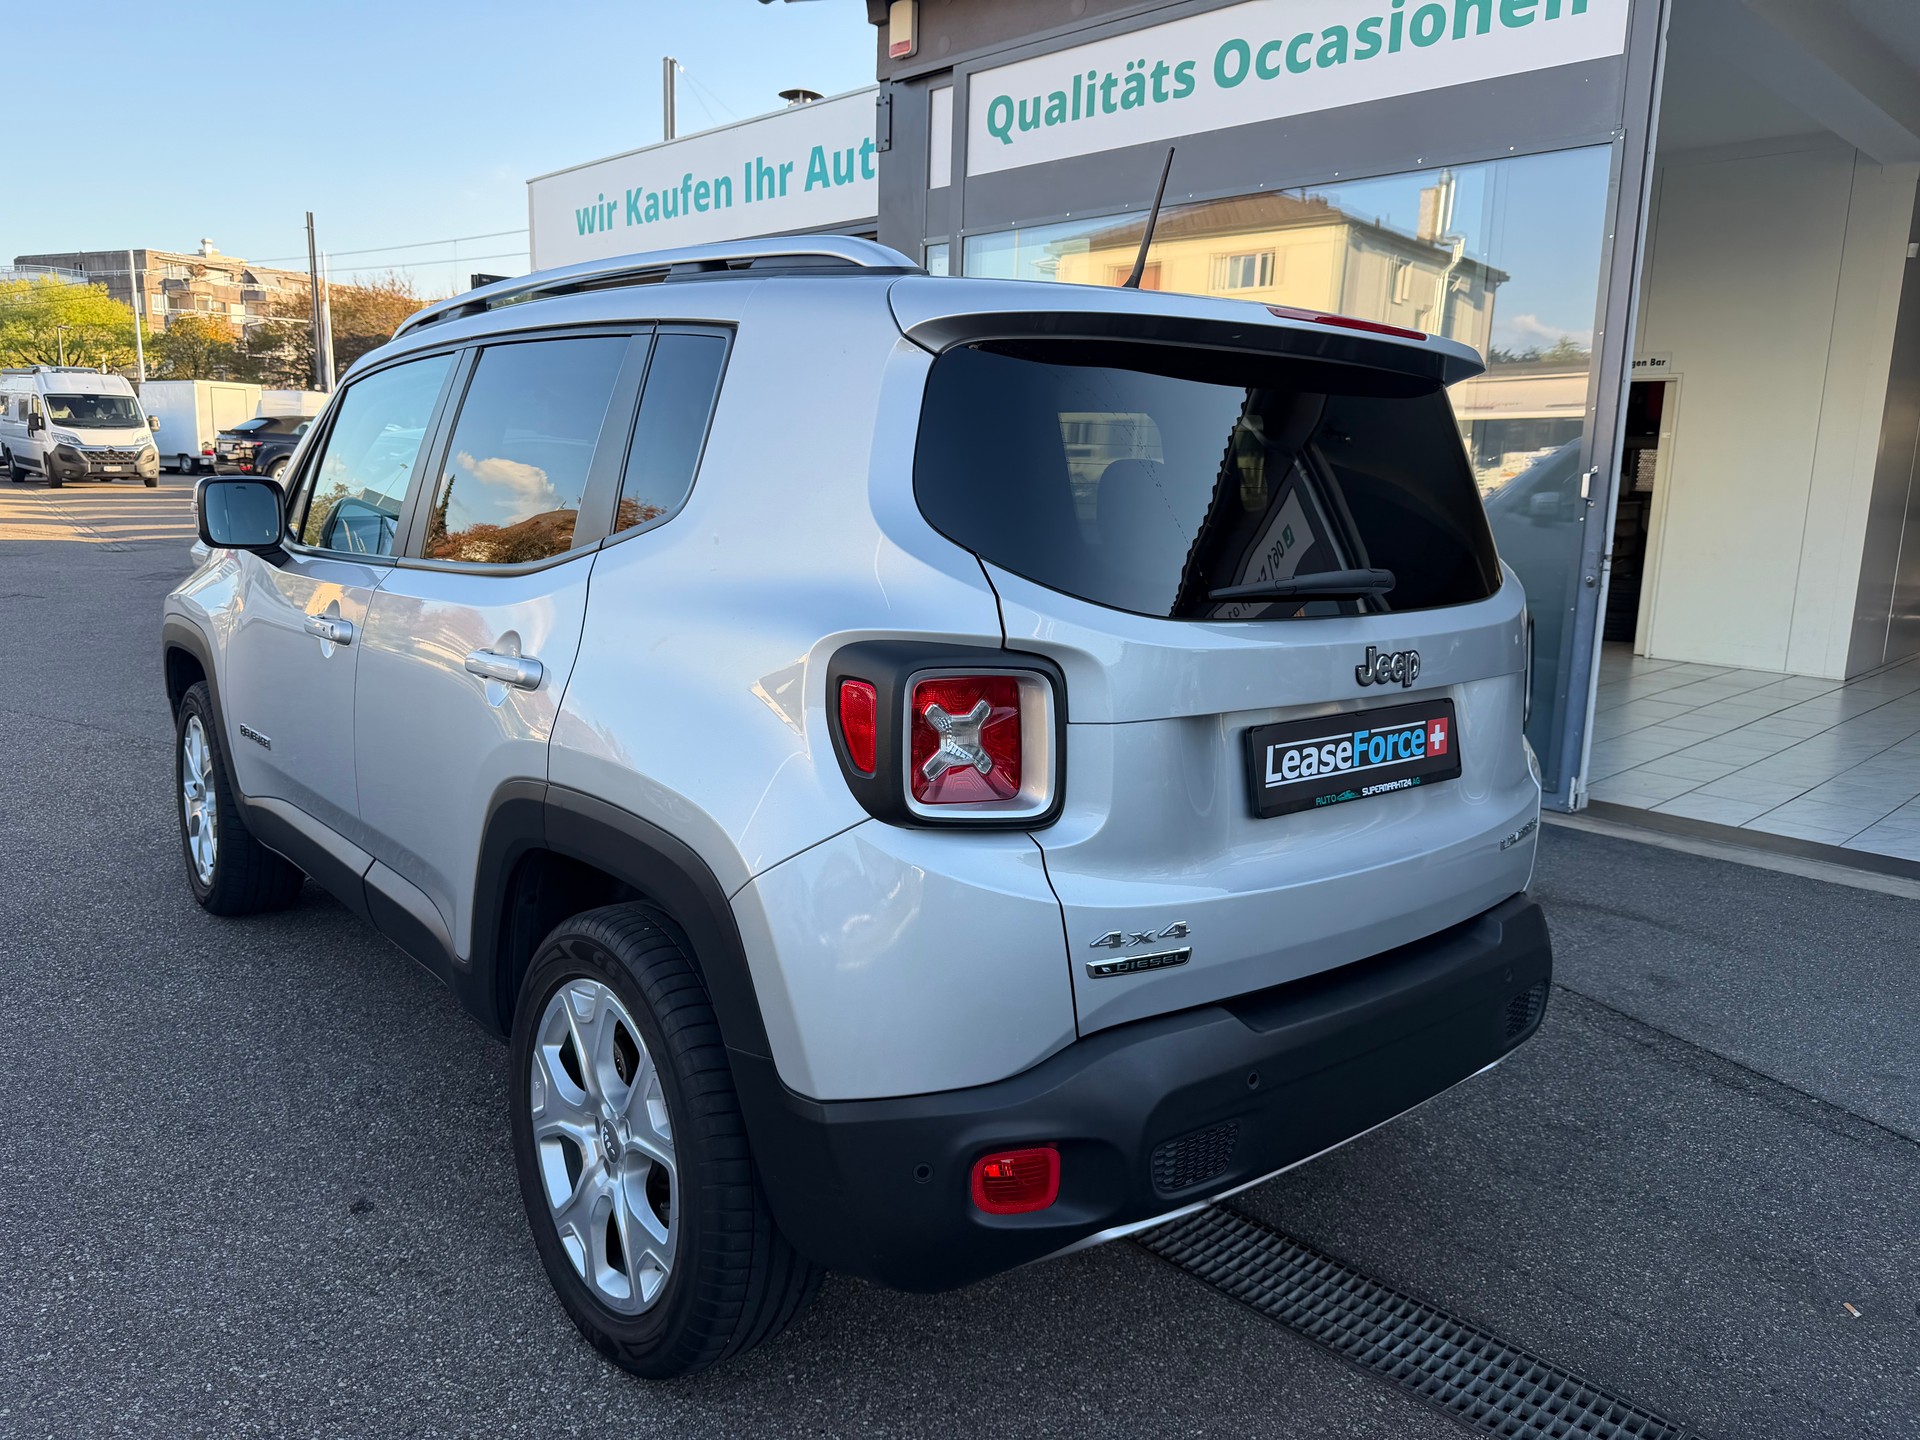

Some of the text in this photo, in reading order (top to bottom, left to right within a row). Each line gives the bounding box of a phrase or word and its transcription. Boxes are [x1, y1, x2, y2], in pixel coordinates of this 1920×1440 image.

[986, 58, 1196, 146] Qualitäts
[575, 137, 876, 236] wir Kaufen Ihr Aut
[1650, 358, 1666, 366] Bar
[1355, 646, 1420, 687] Jeep
[1265, 728, 1426, 784] LeaseForce
[1315, 794, 1337, 806] AUTO
[1412, 776, 1421, 786] AG
[1116, 954, 1185, 971] DIESEL
